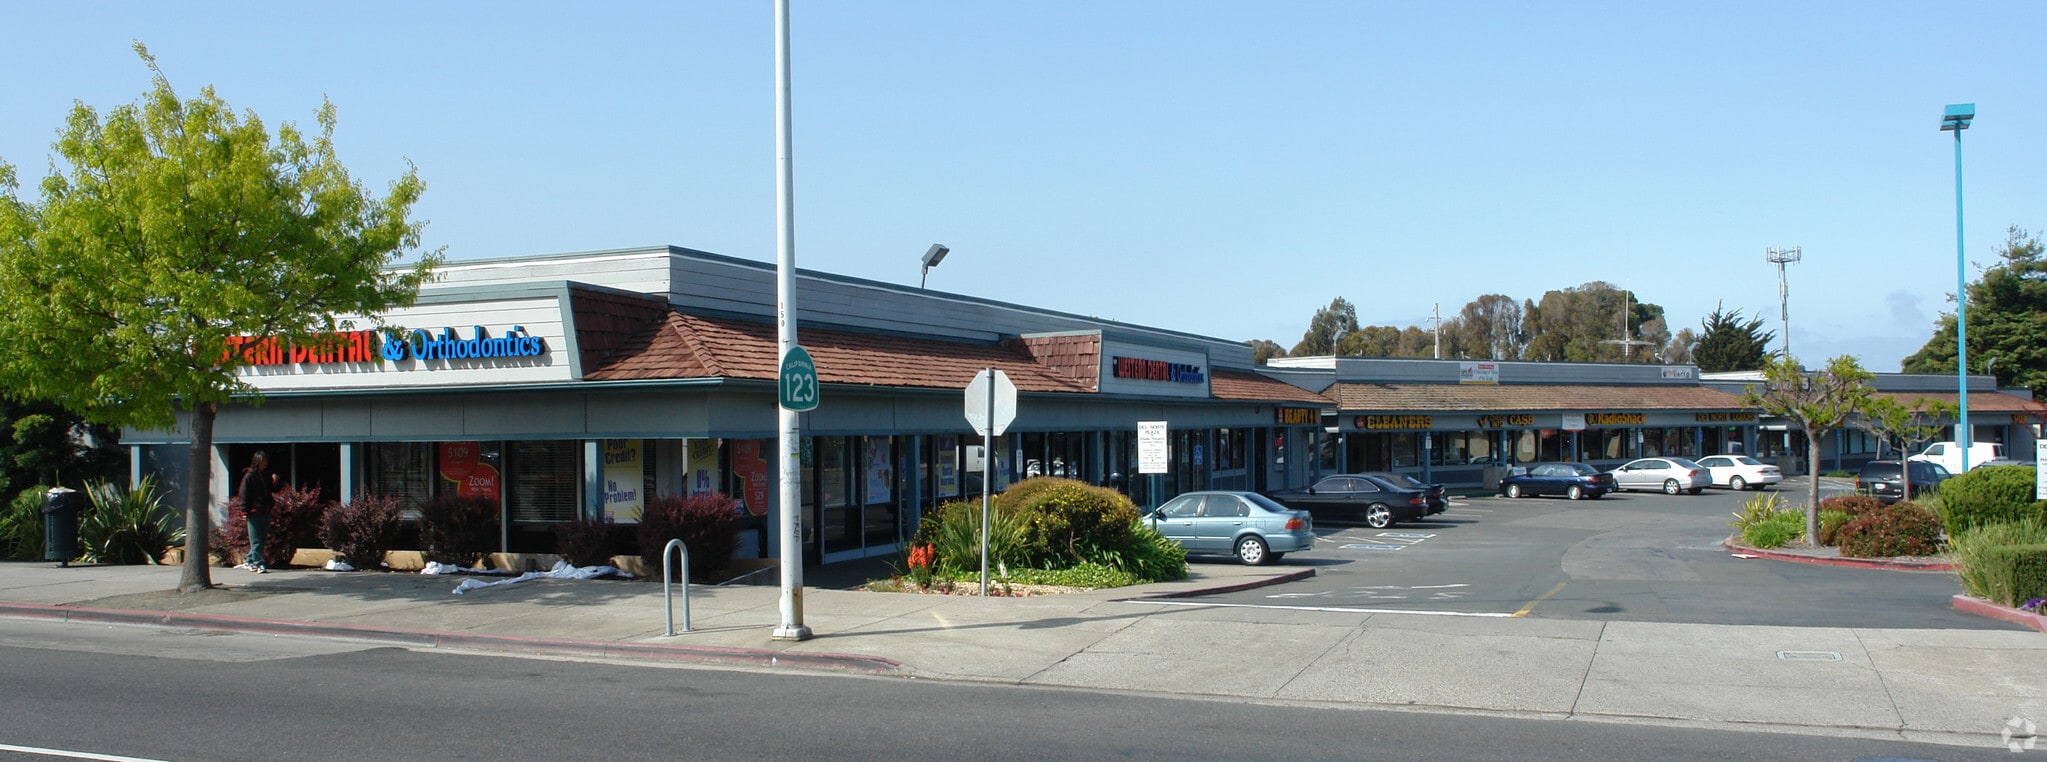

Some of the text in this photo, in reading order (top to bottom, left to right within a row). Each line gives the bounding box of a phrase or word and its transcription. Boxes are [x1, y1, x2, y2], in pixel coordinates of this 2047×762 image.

[382, 332, 404, 360] &
[412, 326, 540, 360] Orthodontics
[785, 373, 814, 402] 123
[1367, 415, 1432, 429] CLEANERS
[1509, 415, 1534, 425] CASH
[1598, 413, 1647, 425] RadioShack
[607, 439, 627, 450] Poor
[447, 447, 469, 458] $109
[605, 448, 636, 464] Credit?
[608, 480, 617, 492] No
[604, 489, 637, 504] Problem!
